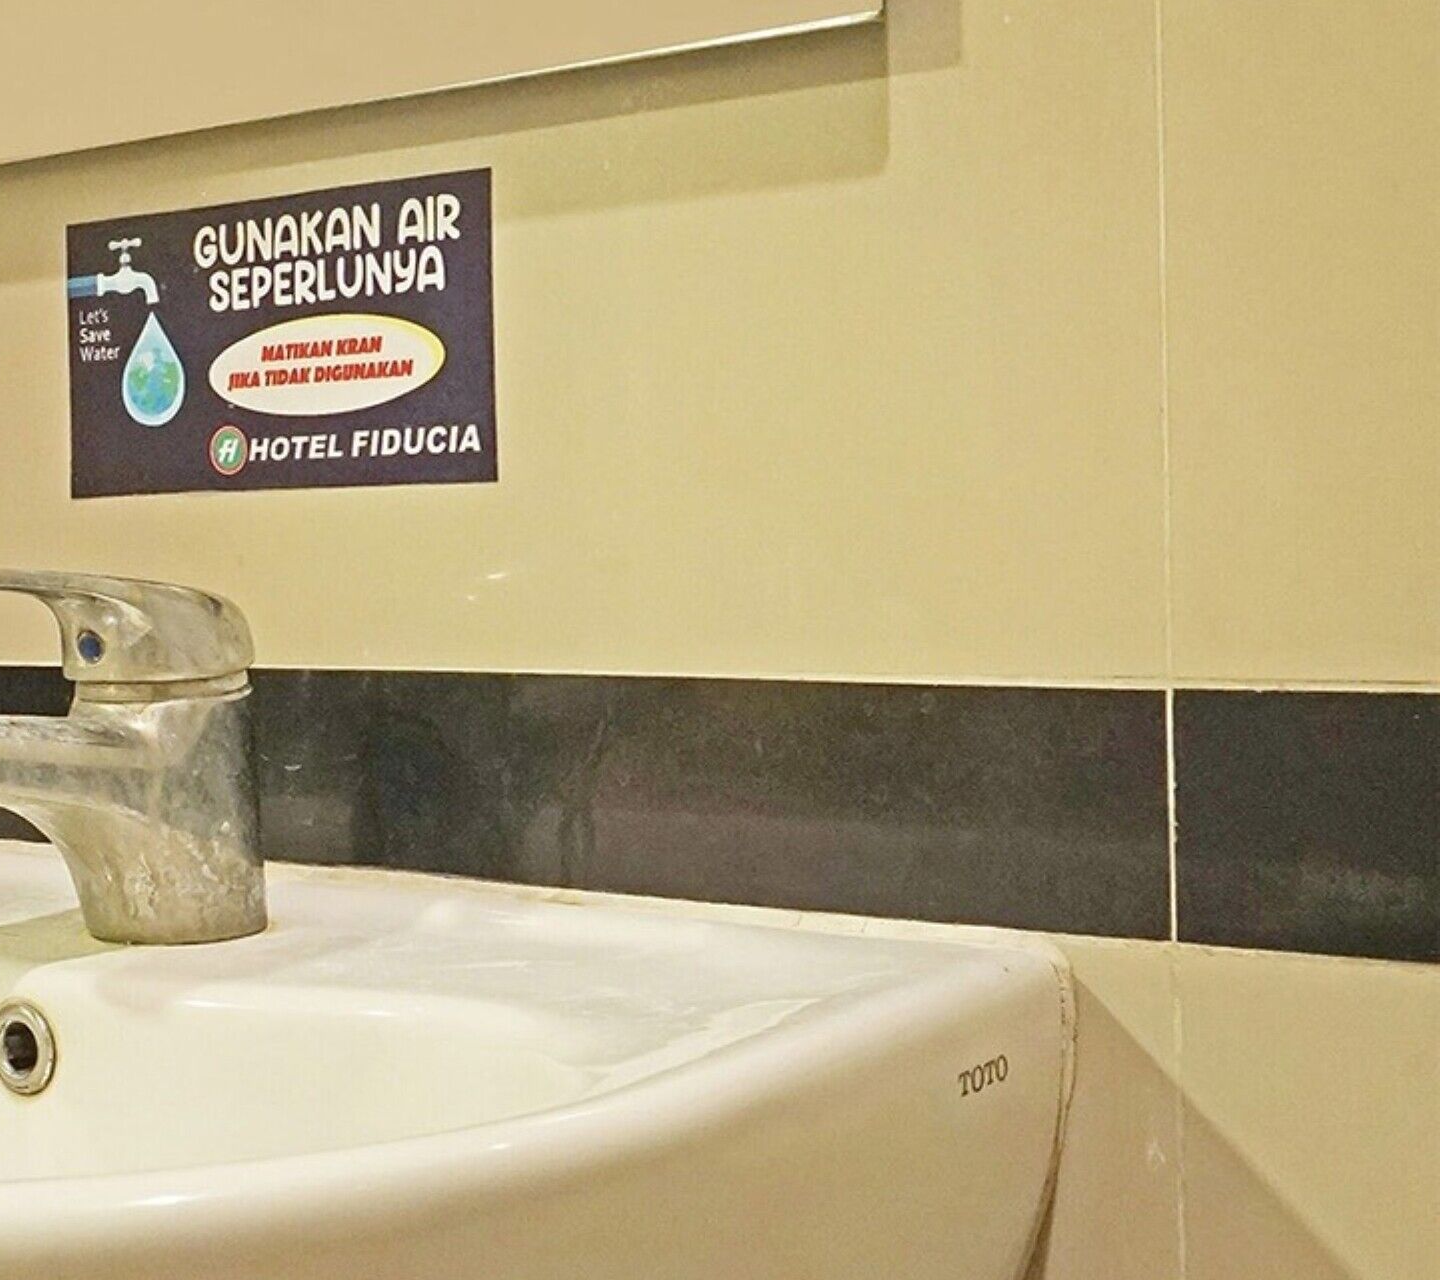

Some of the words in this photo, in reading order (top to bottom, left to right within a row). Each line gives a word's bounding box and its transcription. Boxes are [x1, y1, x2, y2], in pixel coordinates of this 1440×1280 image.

[193, 202, 381, 269] GUNAKAN
[397, 193, 460, 245] AIR
[209, 245, 446, 313] SEPERLUNYA
[78, 308, 109, 325] Let's
[79, 327, 111, 344] Save
[261, 340, 333, 362] MATIKAN
[336, 336, 383, 356] KRAN
[79, 346, 120, 362] Water
[228, 371, 260, 391] JIKA
[265, 368, 311, 387] TIDAK
[314, 359, 413, 384] DIGUNAKAN
[248, 433, 344, 462] HOTEL
[351, 423, 481, 458] FIDUCIA
[958, 1053, 1008, 1098] TOTO
